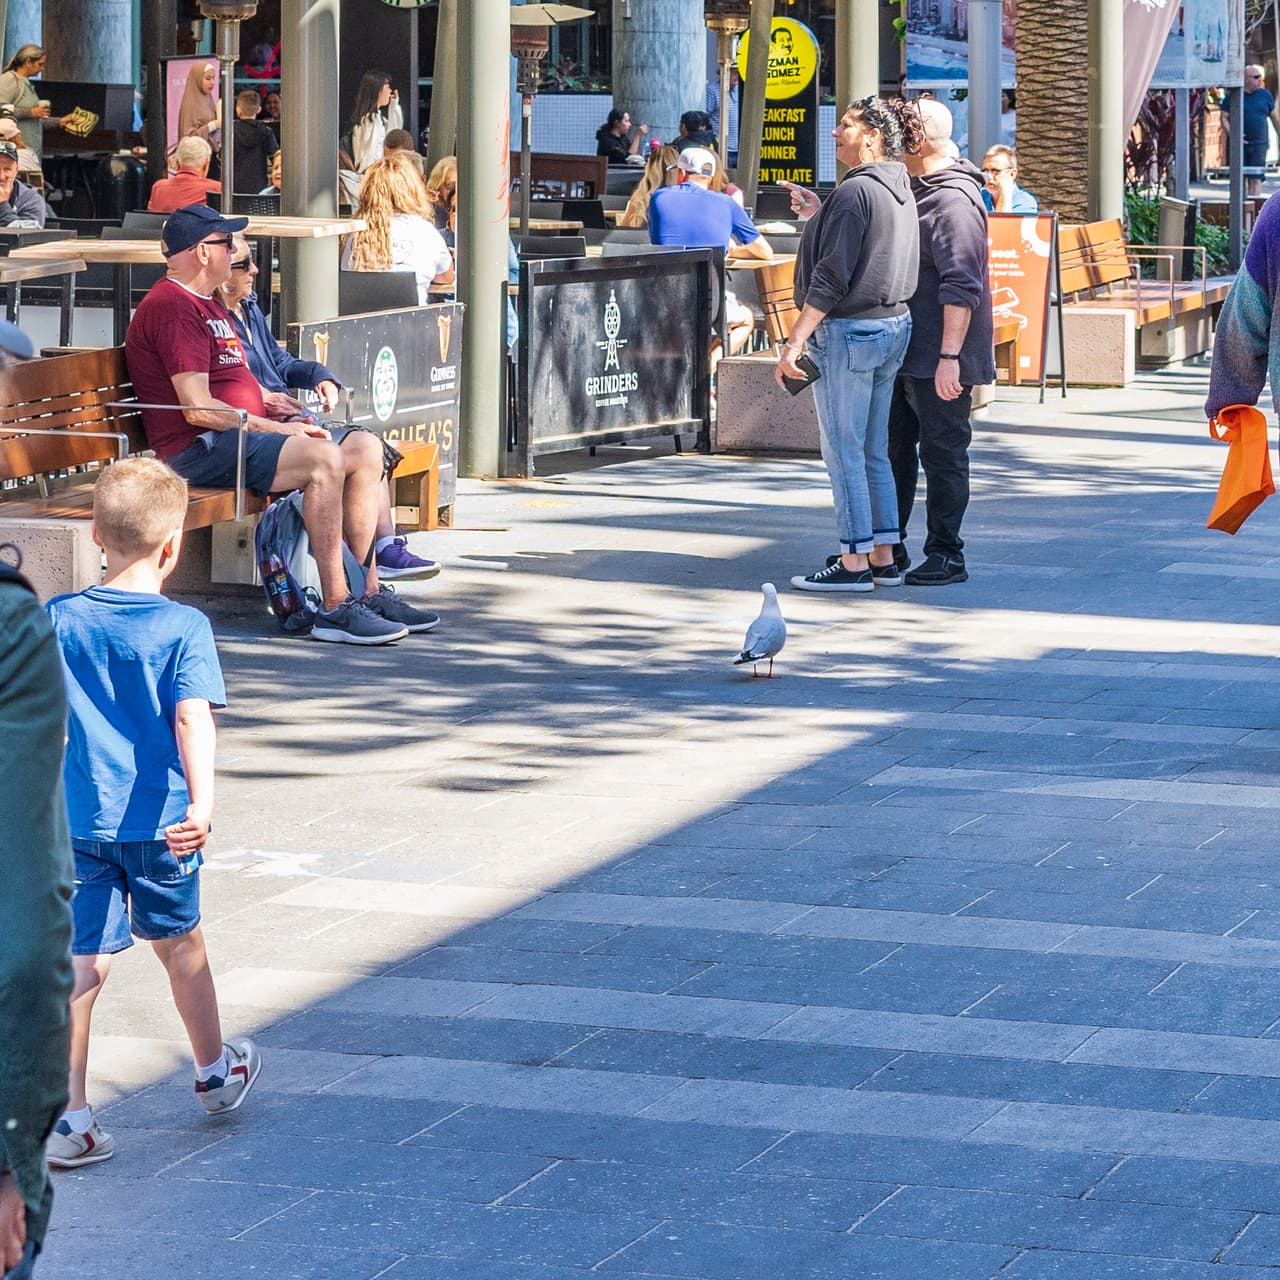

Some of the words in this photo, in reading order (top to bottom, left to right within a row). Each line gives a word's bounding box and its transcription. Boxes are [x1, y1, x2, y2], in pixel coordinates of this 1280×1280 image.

[768, 56, 799, 68] ZMAN
[762, 108, 806, 123] EAKFAST
[758, 169, 768, 182] EN
[786, 168, 812, 183] LATE
[585, 372, 638, 396] GRINDERS
